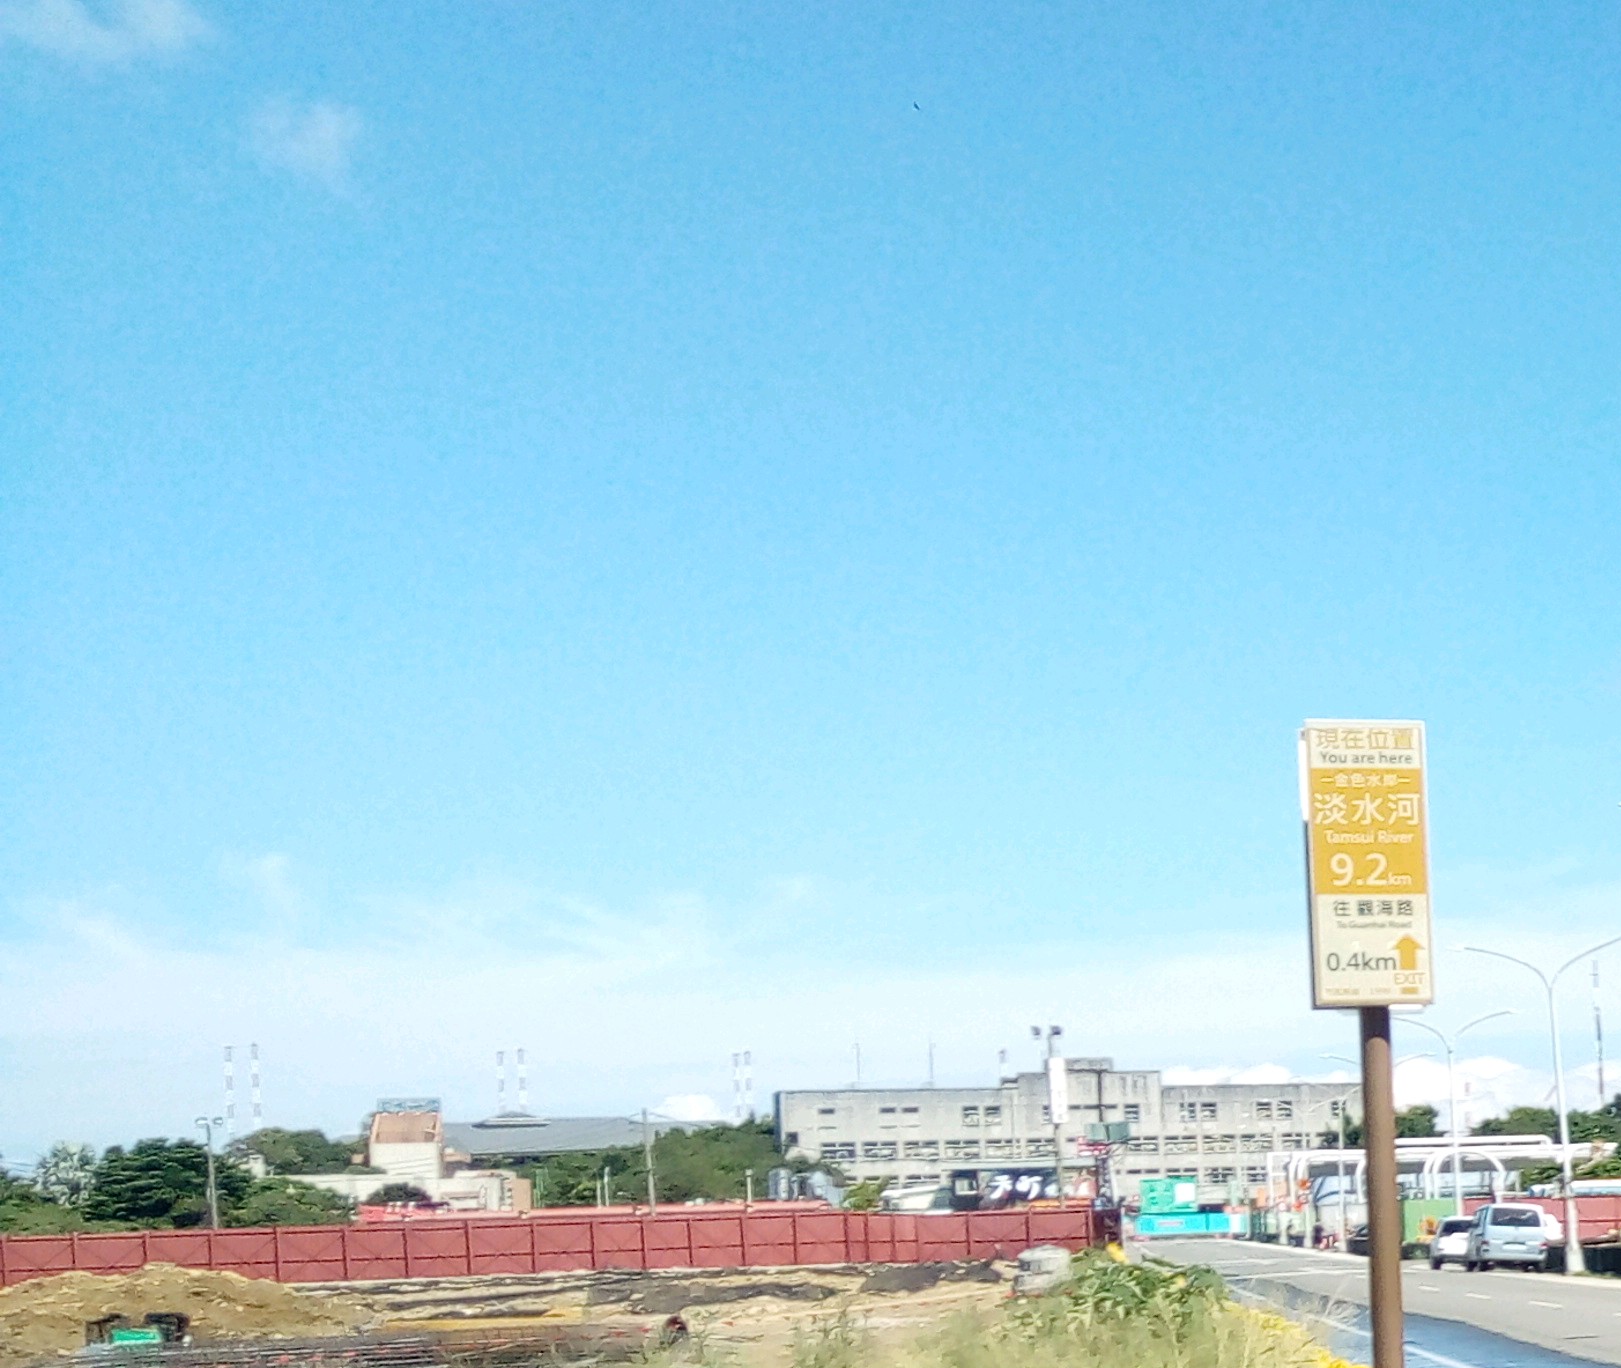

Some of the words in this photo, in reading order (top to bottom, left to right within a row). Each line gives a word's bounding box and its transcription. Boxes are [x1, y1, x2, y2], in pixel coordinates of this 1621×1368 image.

[1316, 728, 1414, 750] 現在位置
[1321, 752, 1348, 764] You
[1352, 754, 1375, 764] are
[1379, 752, 1412, 764] here
[1313, 792, 1420, 825] 淡水河
[1324, 829, 1375, 844] Tamsui
[1378, 829, 1415, 844] River
[1326, 951, 1397, 972] 0.4km
[1393, 972, 1426, 985] EXIT
